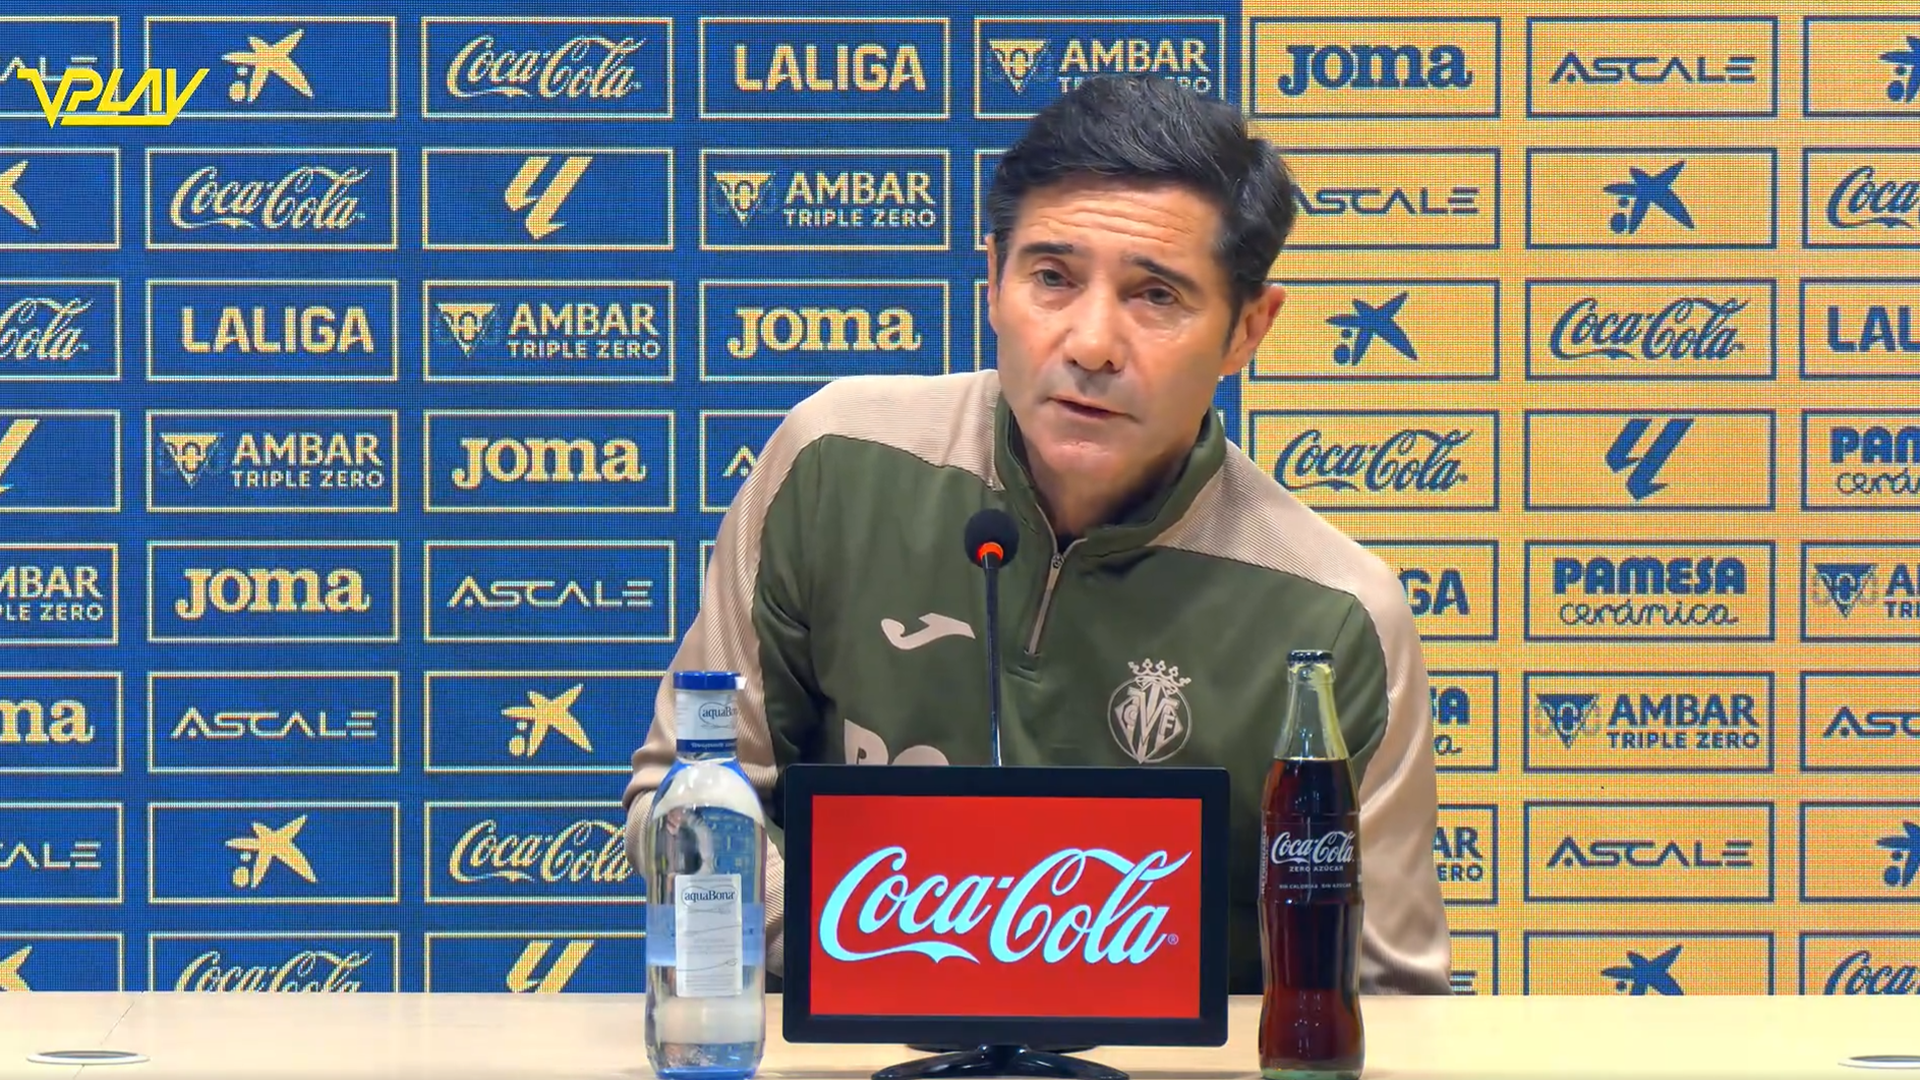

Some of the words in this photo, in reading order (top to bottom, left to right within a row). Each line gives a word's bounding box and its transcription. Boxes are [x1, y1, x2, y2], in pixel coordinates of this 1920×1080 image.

[446, 36, 645, 98] Coca-Cola
[735, 45, 927, 91] LALIGA
[1059, 39, 1211, 73] AMBAR
[1549, 52, 1757, 84] ASCALE
[170, 166, 370, 229] Coca-Cola
[785, 171, 936, 205] AMBAR
[784, 208, 863, 227] TRIPLE
[873, 208, 937, 228] ZERO
[182, 306, 375, 353] LALIGA
[509, 303, 659, 336] AMBAR
[1548, 297, 1749, 361] Coca-Cola
[1827, 305, 1920, 353] LAL
[508, 340, 588, 359] TRIPLE
[597, 341, 661, 359] ZERO
[232, 433, 382, 466] AMBAR
[1274, 429, 1474, 492] Coca-Cola
[232, 470, 312, 488] TRIPLE
[320, 470, 385, 489] ZERO
[449, 575, 653, 607] ASCALE
[1553, 557, 1747, 595] PAMESA
[40, 603, 104, 621] ZERO
[1560, 599, 1740, 626] cerámica
[172, 707, 377, 738] ASCALE
[1607, 693, 1760, 727] AMBAR
[1606, 731, 1687, 750] TRIPLE
[1695, 731, 1761, 750] ZERO
[1271, 831, 1356, 864] Coca-Cola
[1546, 836, 1753, 868] ASCALE
[1289, 865, 1311, 873] ZERO
[1437, 864, 1484, 882] ERO
[684, 890, 734, 903] aquaBona
[819, 846, 1192, 965] Coca-Cola
